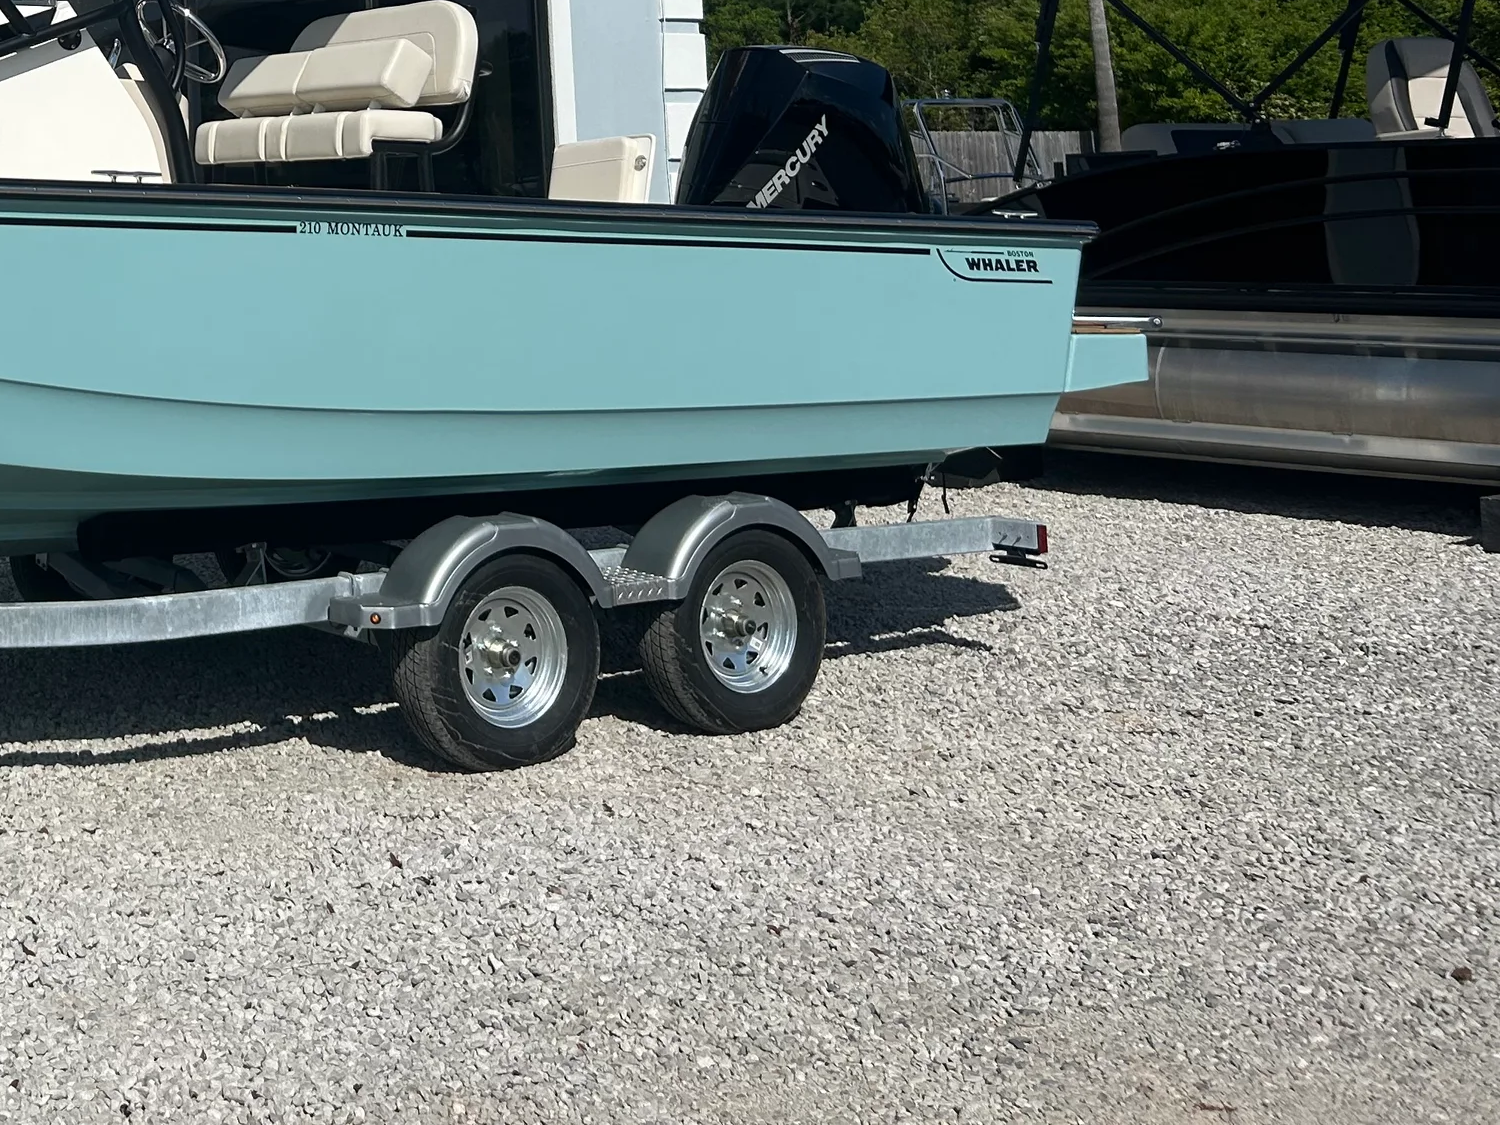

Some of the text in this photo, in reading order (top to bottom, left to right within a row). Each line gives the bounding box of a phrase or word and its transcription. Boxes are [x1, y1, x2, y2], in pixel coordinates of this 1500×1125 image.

[746, 113, 829, 209] MERCURY
[299, 221, 404, 237] 210 MONTAUK
[1007, 250, 1035, 258] BOSTON
[965, 257, 1040, 273] WHALER
